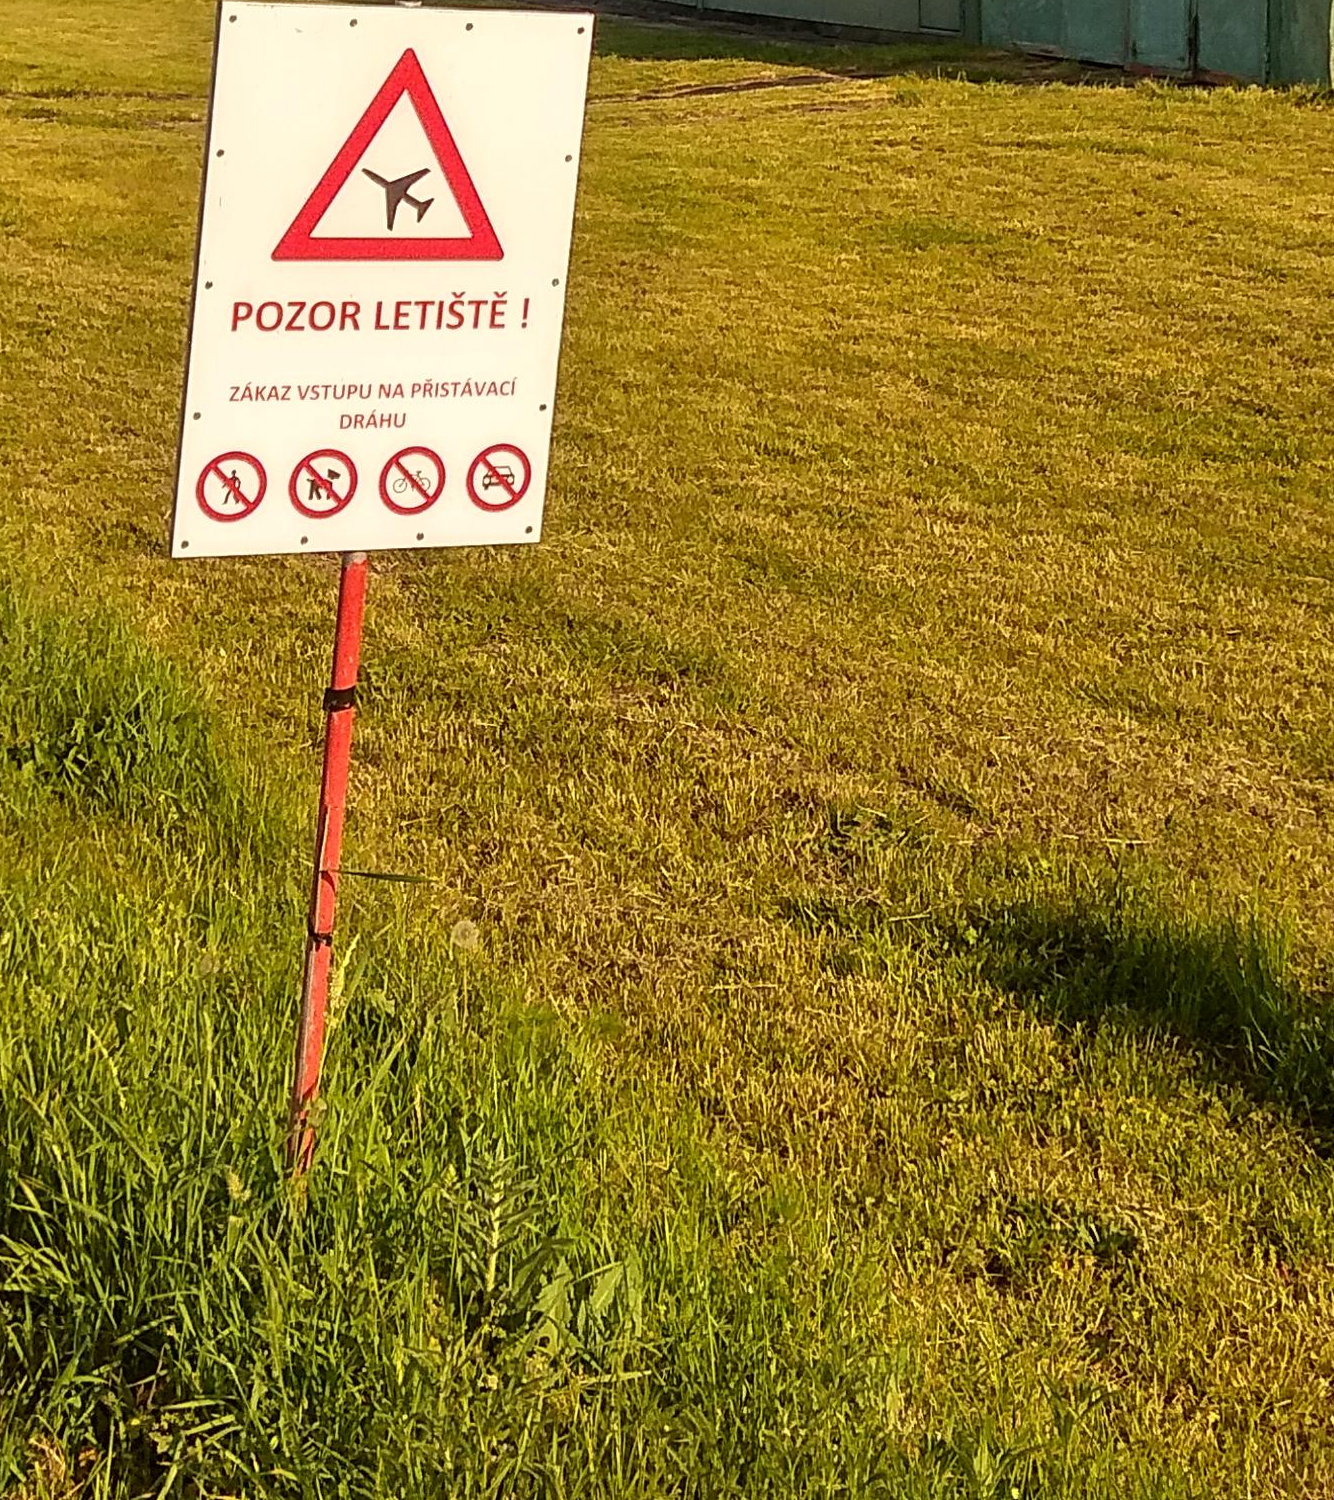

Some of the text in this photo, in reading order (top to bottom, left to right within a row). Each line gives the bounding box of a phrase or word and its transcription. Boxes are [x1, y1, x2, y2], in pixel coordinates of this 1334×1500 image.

[231, 291, 530, 333] POZOR LETIŠTĚ !
[229, 377, 516, 402] ZÁKAZ VSTUPU NA PŘISTÁVACÍ
[339, 408, 407, 430] DRÁHU
